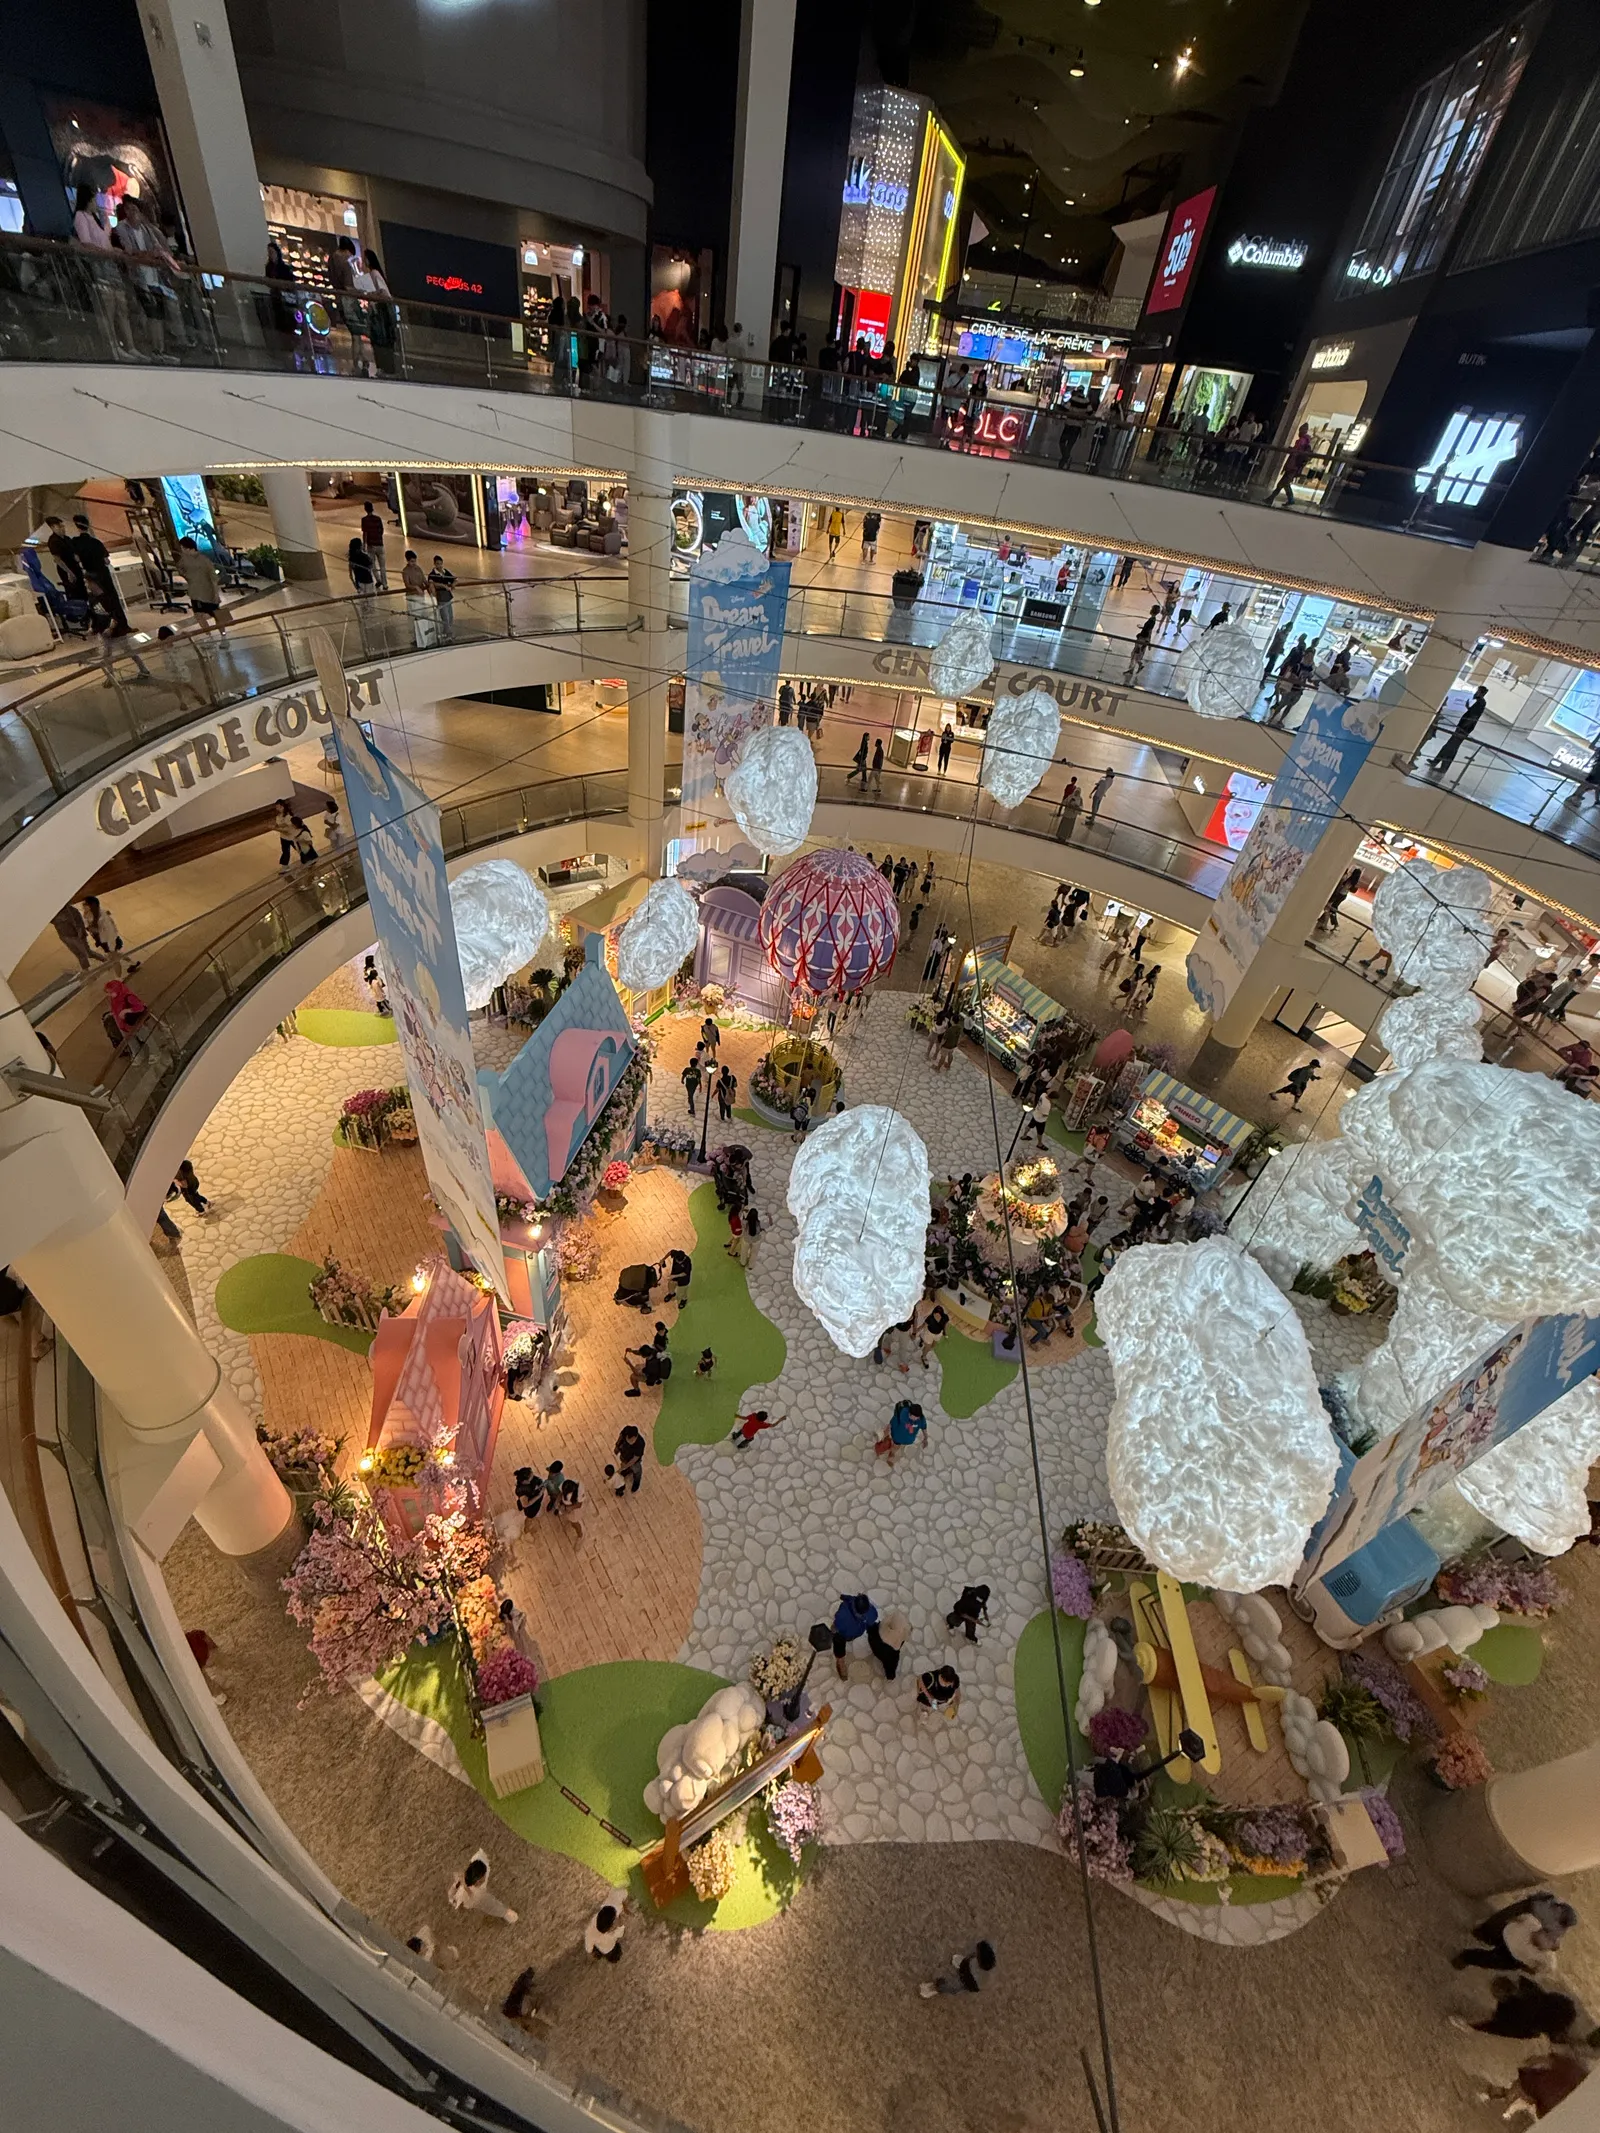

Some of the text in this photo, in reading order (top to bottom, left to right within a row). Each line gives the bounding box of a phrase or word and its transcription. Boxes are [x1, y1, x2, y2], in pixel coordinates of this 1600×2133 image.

[1242, 244, 1304, 268] Columbia
[426, 275, 483, 294] PEGUS 42
[971, 323, 1007, 339] CRÈME
[1035, 332, 1048, 346] LA
[1056, 334, 1095, 353] CRÈME
[701, 596, 769, 632] Dream
[1030, 610, 1057, 621] SAMSUNG
[704, 624, 779, 664] Travel
[872, 648, 1001, 692] CENE
[97, 668, 384, 837] CENTRE COURT
[1300, 719, 1344, 774] Dream
[1174, 1105, 1201, 1124] MINISO
[1363, 1174, 1411, 1253] Dream
[1355, 1199, 1404, 1279] Travel
